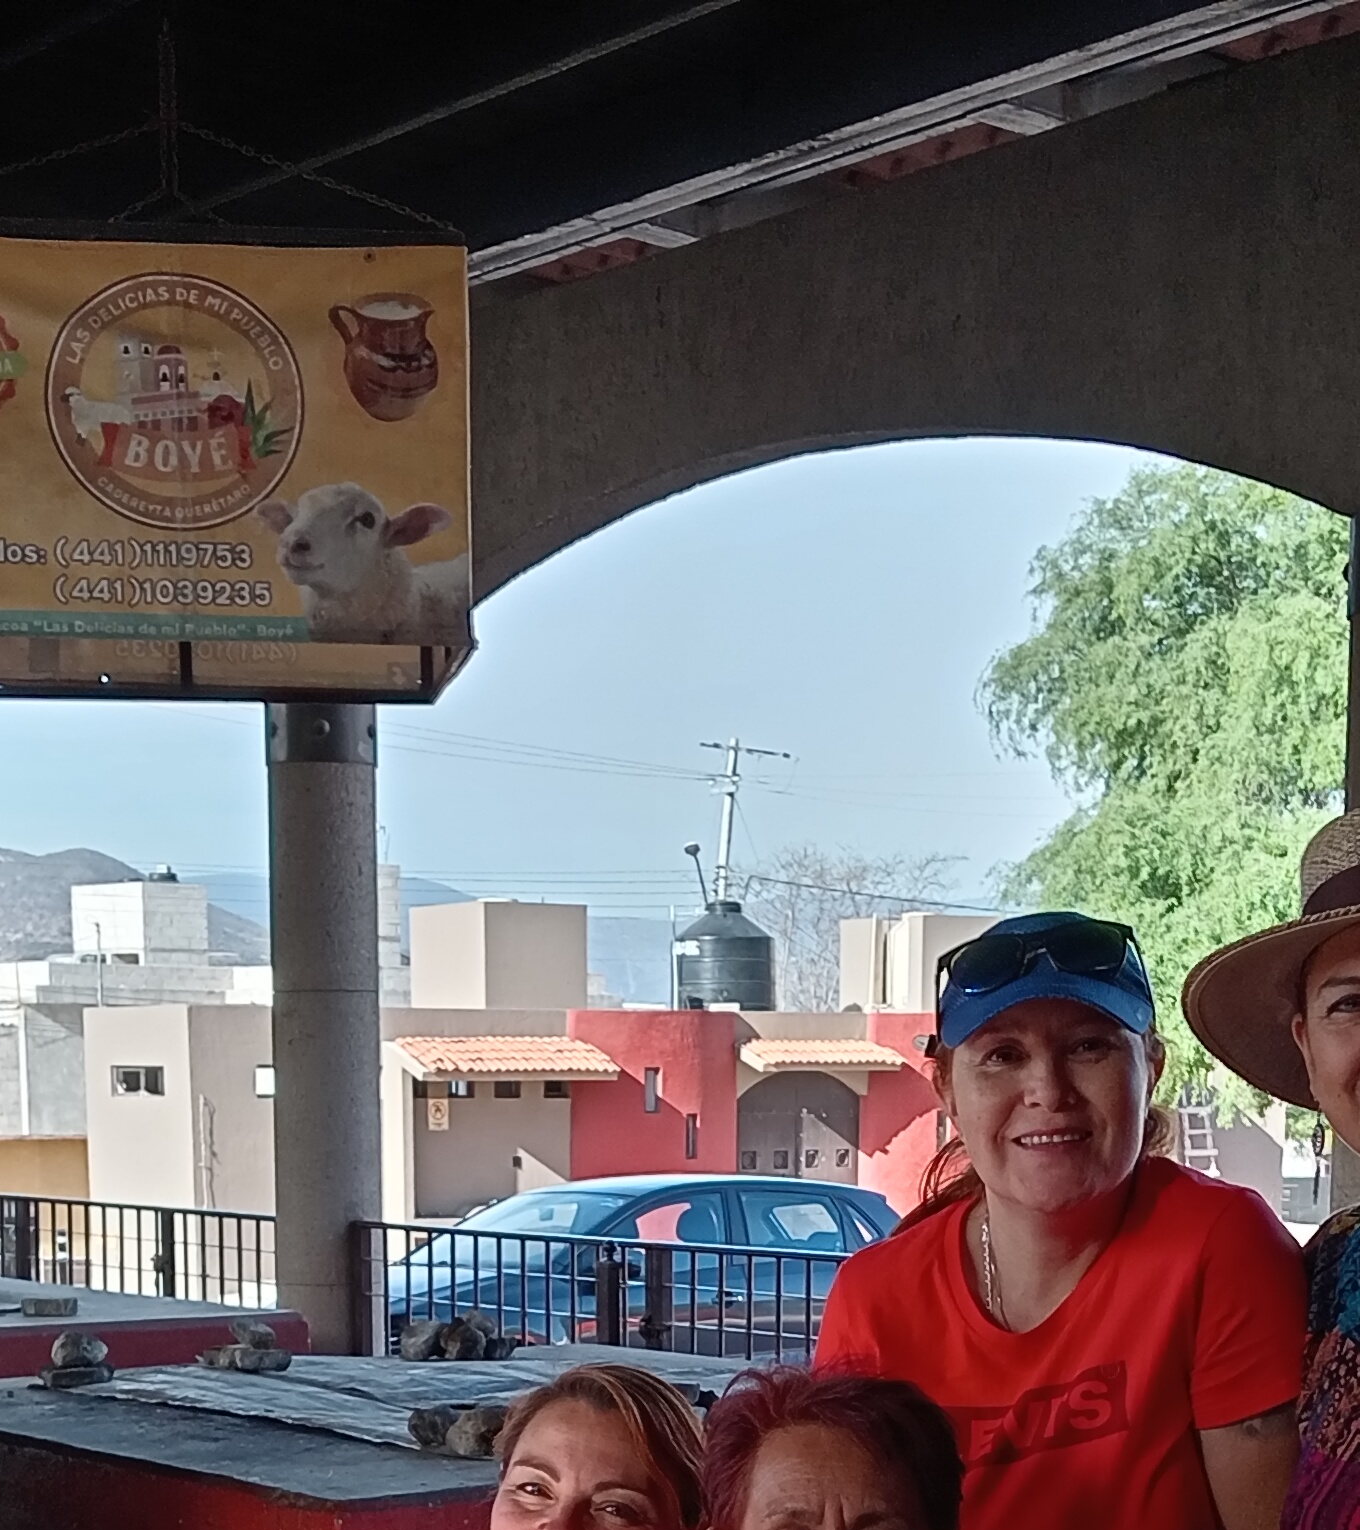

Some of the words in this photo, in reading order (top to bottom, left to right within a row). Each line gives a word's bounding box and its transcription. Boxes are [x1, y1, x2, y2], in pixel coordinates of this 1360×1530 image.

[66, 328, 91, 364] LAS
[90, 286, 169, 329] DELICIAS
[175, 287, 199, 303] DE
[204, 295, 230, 315] MI
[229, 307, 284, 371] PUEBLO
[124, 431, 233, 473] BOYÉ
[97, 476, 171, 517] CADEREYTA
[175, 484, 250, 518] QUERÉTARO
[55, 536, 254, 569] (441)1119753
[54, 574, 272, 608] (441)1039235
[74, 621, 135, 634] Delicias
[138, 624, 156, 636] de
[160, 623, 180, 635] mi
[256, 624, 294, 638] Boyé
